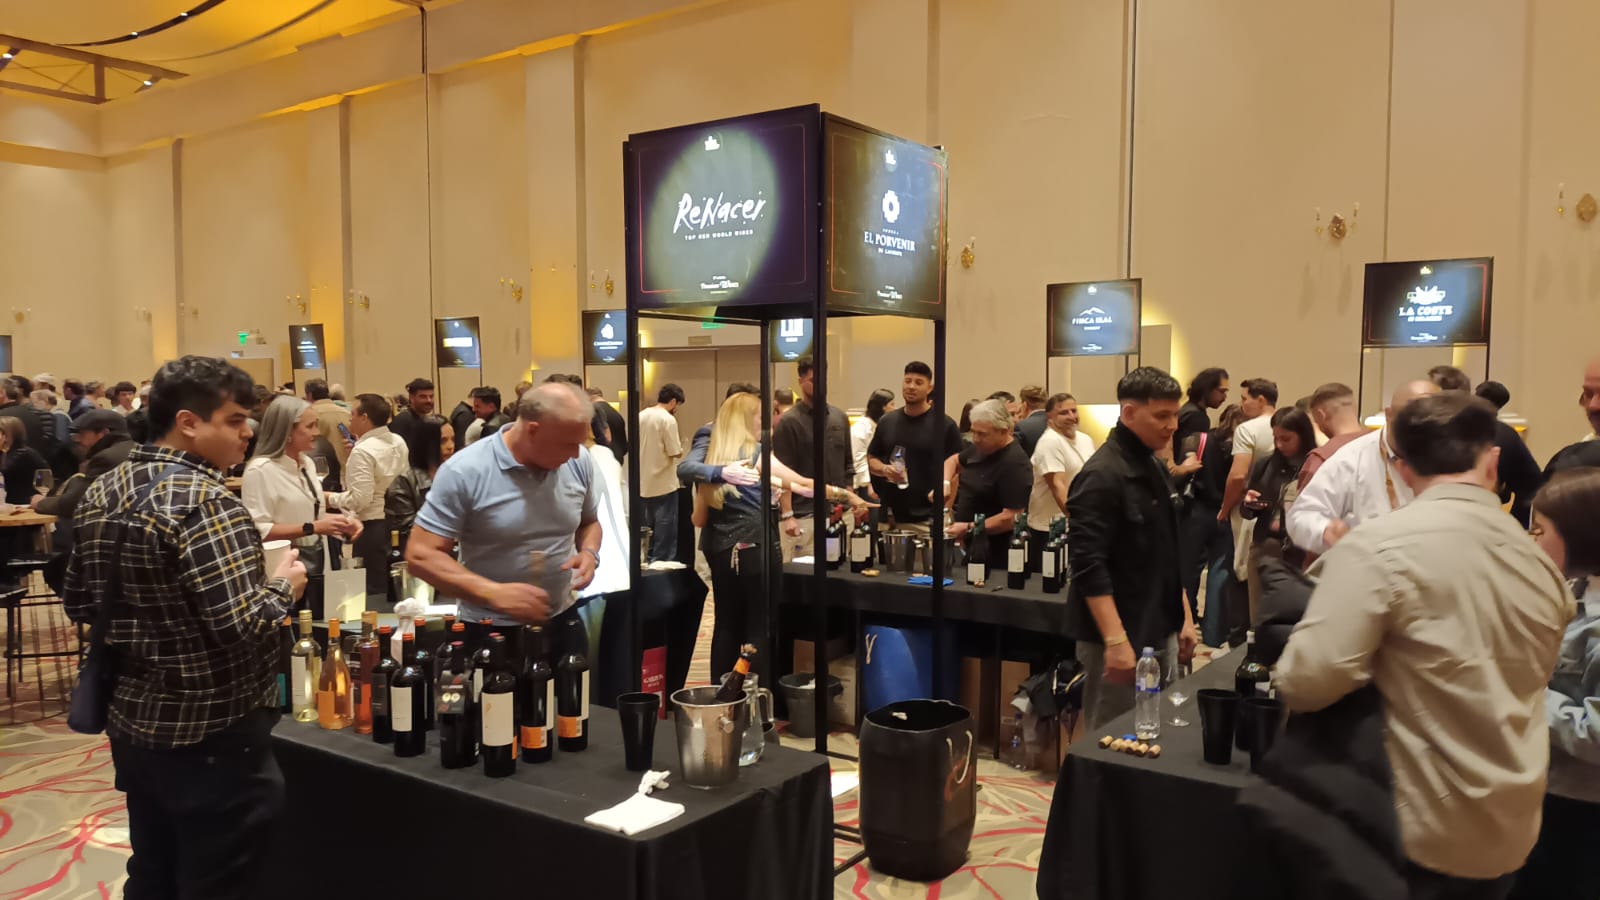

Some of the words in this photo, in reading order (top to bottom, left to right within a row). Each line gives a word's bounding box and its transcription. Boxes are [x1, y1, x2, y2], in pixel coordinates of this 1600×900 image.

[864, 231, 875, 245] EL
[875, 233, 916, 251] PORVENIR
[1398, 306, 1415, 316] LA
